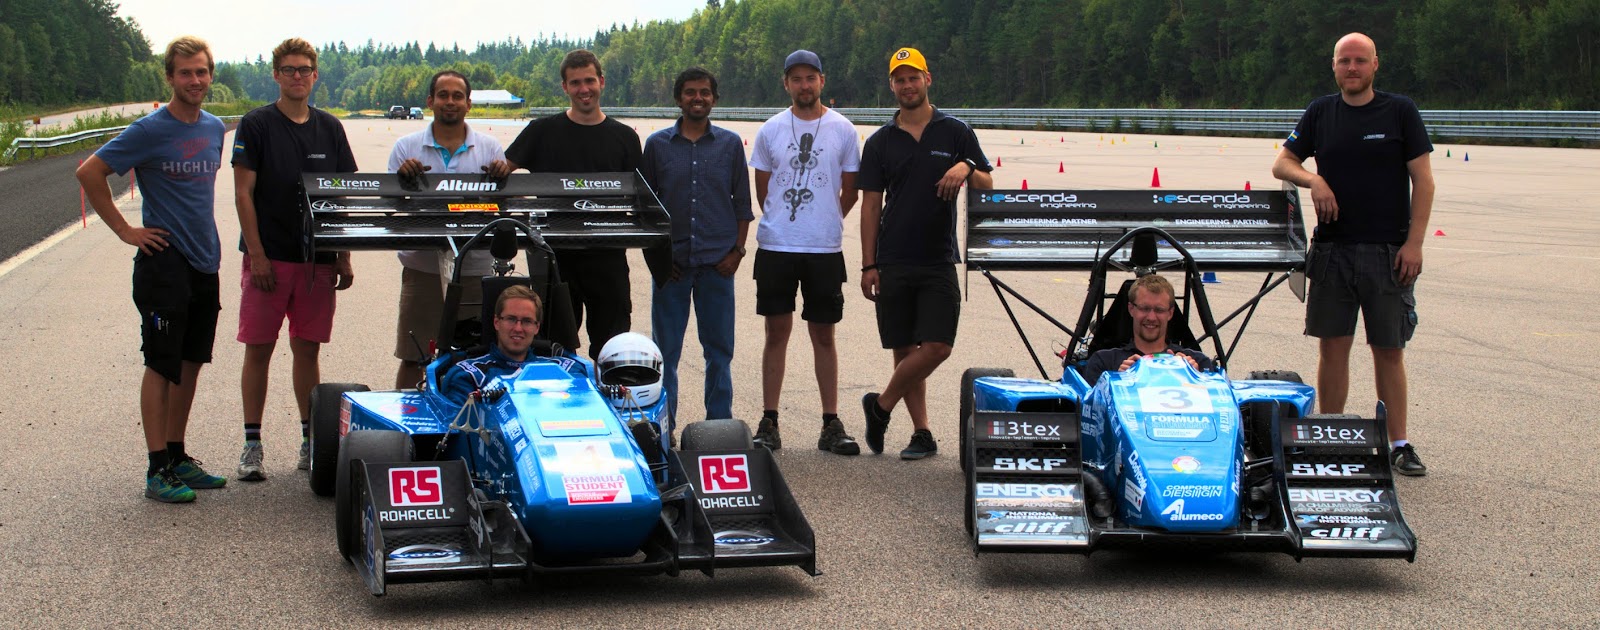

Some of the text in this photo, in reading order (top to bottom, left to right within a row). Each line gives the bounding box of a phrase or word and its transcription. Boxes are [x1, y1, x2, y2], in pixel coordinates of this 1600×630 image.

[162, 161, 201, 174] HIGH
[316, 177, 380, 187] TeXtreme
[435, 179, 497, 191] Altium
[560, 178, 622, 188] TeXtreme
[992, 192, 1078, 203] escenda
[1164, 192, 1250, 204] escenda
[1040, 202, 1097, 210] engineering
[1158, 388, 1193, 410] 3
[1151, 415, 1210, 423] FORMULA
[1008, 421, 1061, 436] 3tex
[1311, 425, 1366, 440] 3tex
[993, 458, 1067, 471] SKF
[1291, 463, 1366, 476] SKF
[564, 475, 625, 484] FORMULA
[701, 457, 748, 491] RS
[393, 469, 442, 504] RS
[566, 482, 624, 491] STUDENT
[976, 483, 1077, 497] ENERGY
[1288, 489, 1384, 503] ENERGY
[1170, 511, 1224, 521] alumeco
[994, 521, 1071, 533] cliff
[1310, 527, 1385, 538] cliff
